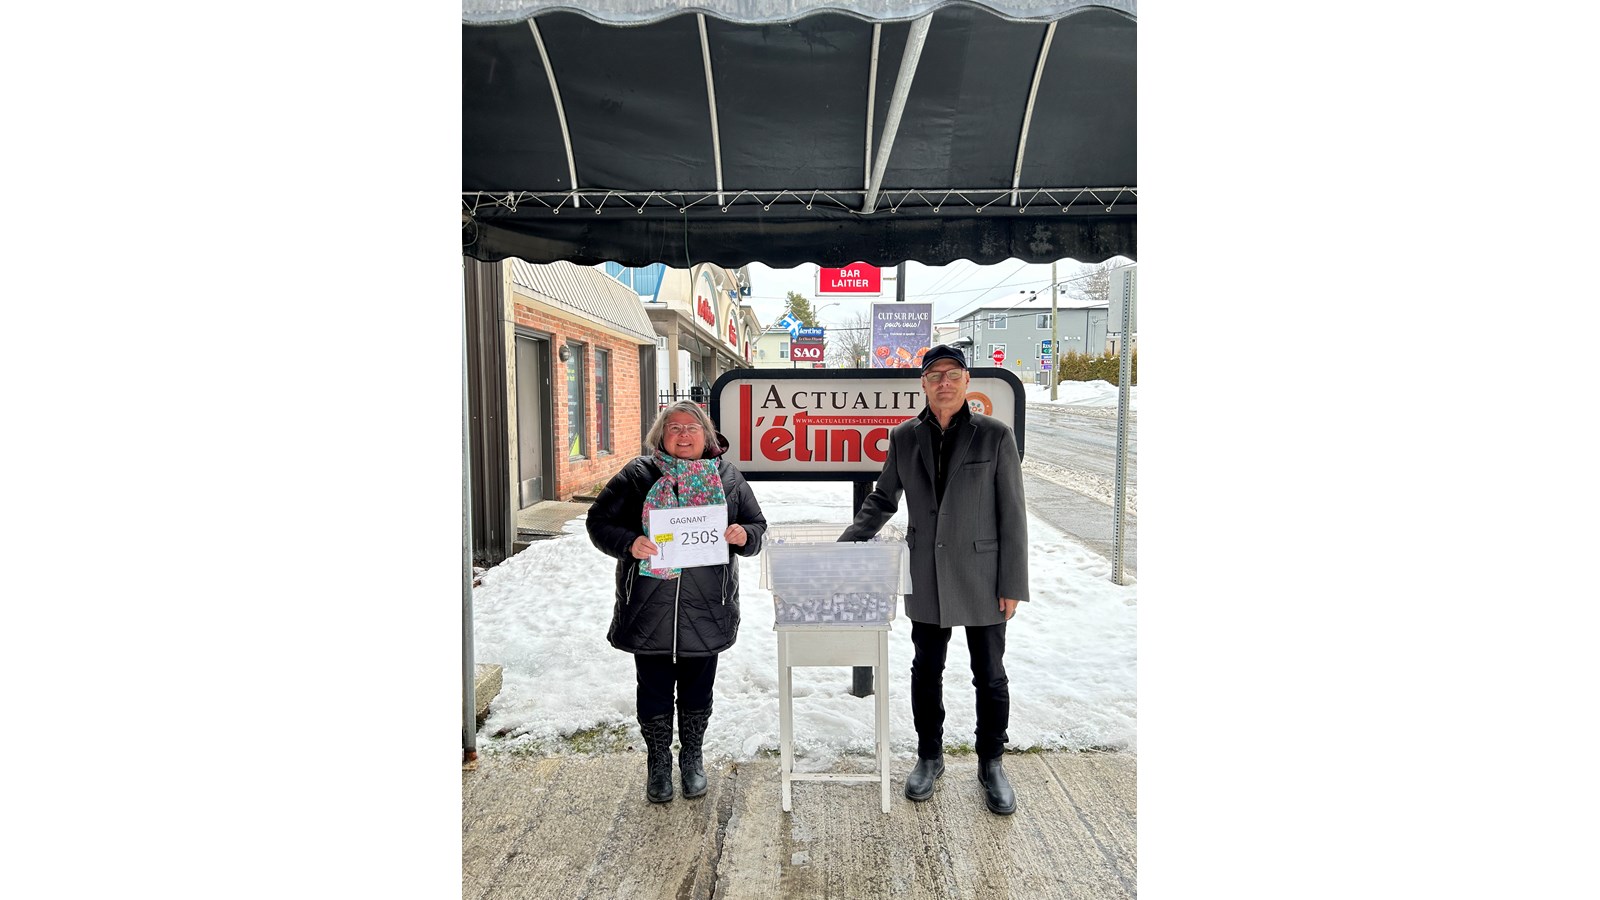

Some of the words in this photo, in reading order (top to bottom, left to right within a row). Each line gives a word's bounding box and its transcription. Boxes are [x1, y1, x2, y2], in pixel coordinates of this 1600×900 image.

[840, 269, 860, 278] BAR
[831, 279, 869, 288] LAITIER
[878, 312, 893, 320] CUIT
[894, 312, 907, 320] SUR
[908, 312, 929, 320] PLACE
[884, 321, 901, 330] pour
[793, 347, 820, 358] SAQ
[760, 384, 925, 409] ACTUALIT
[740, 384, 890, 463] l'étinc
[670, 515, 707, 525] GAGNANT
[681, 528, 719, 545] 250$
